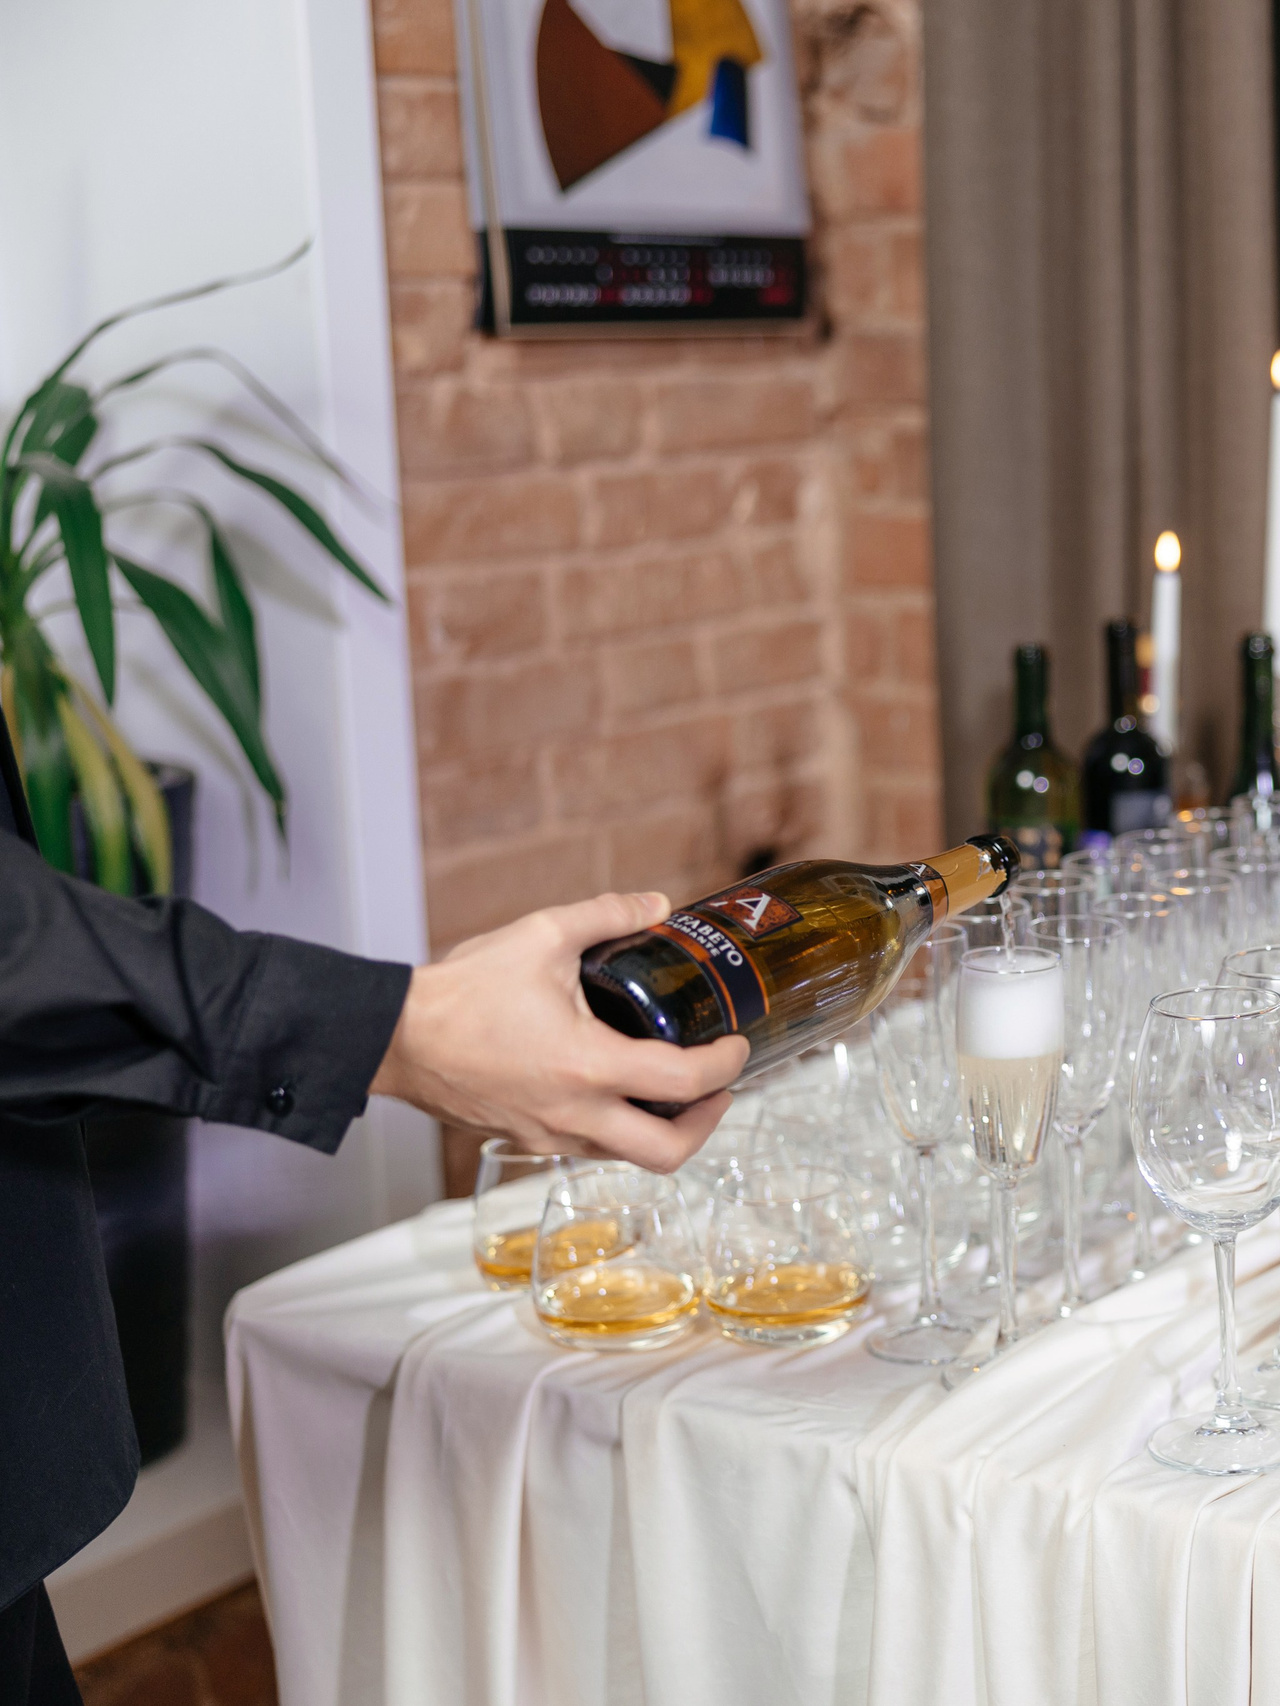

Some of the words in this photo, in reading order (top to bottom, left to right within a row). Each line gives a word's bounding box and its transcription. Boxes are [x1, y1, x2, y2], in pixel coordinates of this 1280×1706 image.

[909, 863, 927, 877] A
[709, 892, 772, 931] A
[664, 920, 721, 957] PUMANTE
[670, 913, 743, 967] LFABETO
